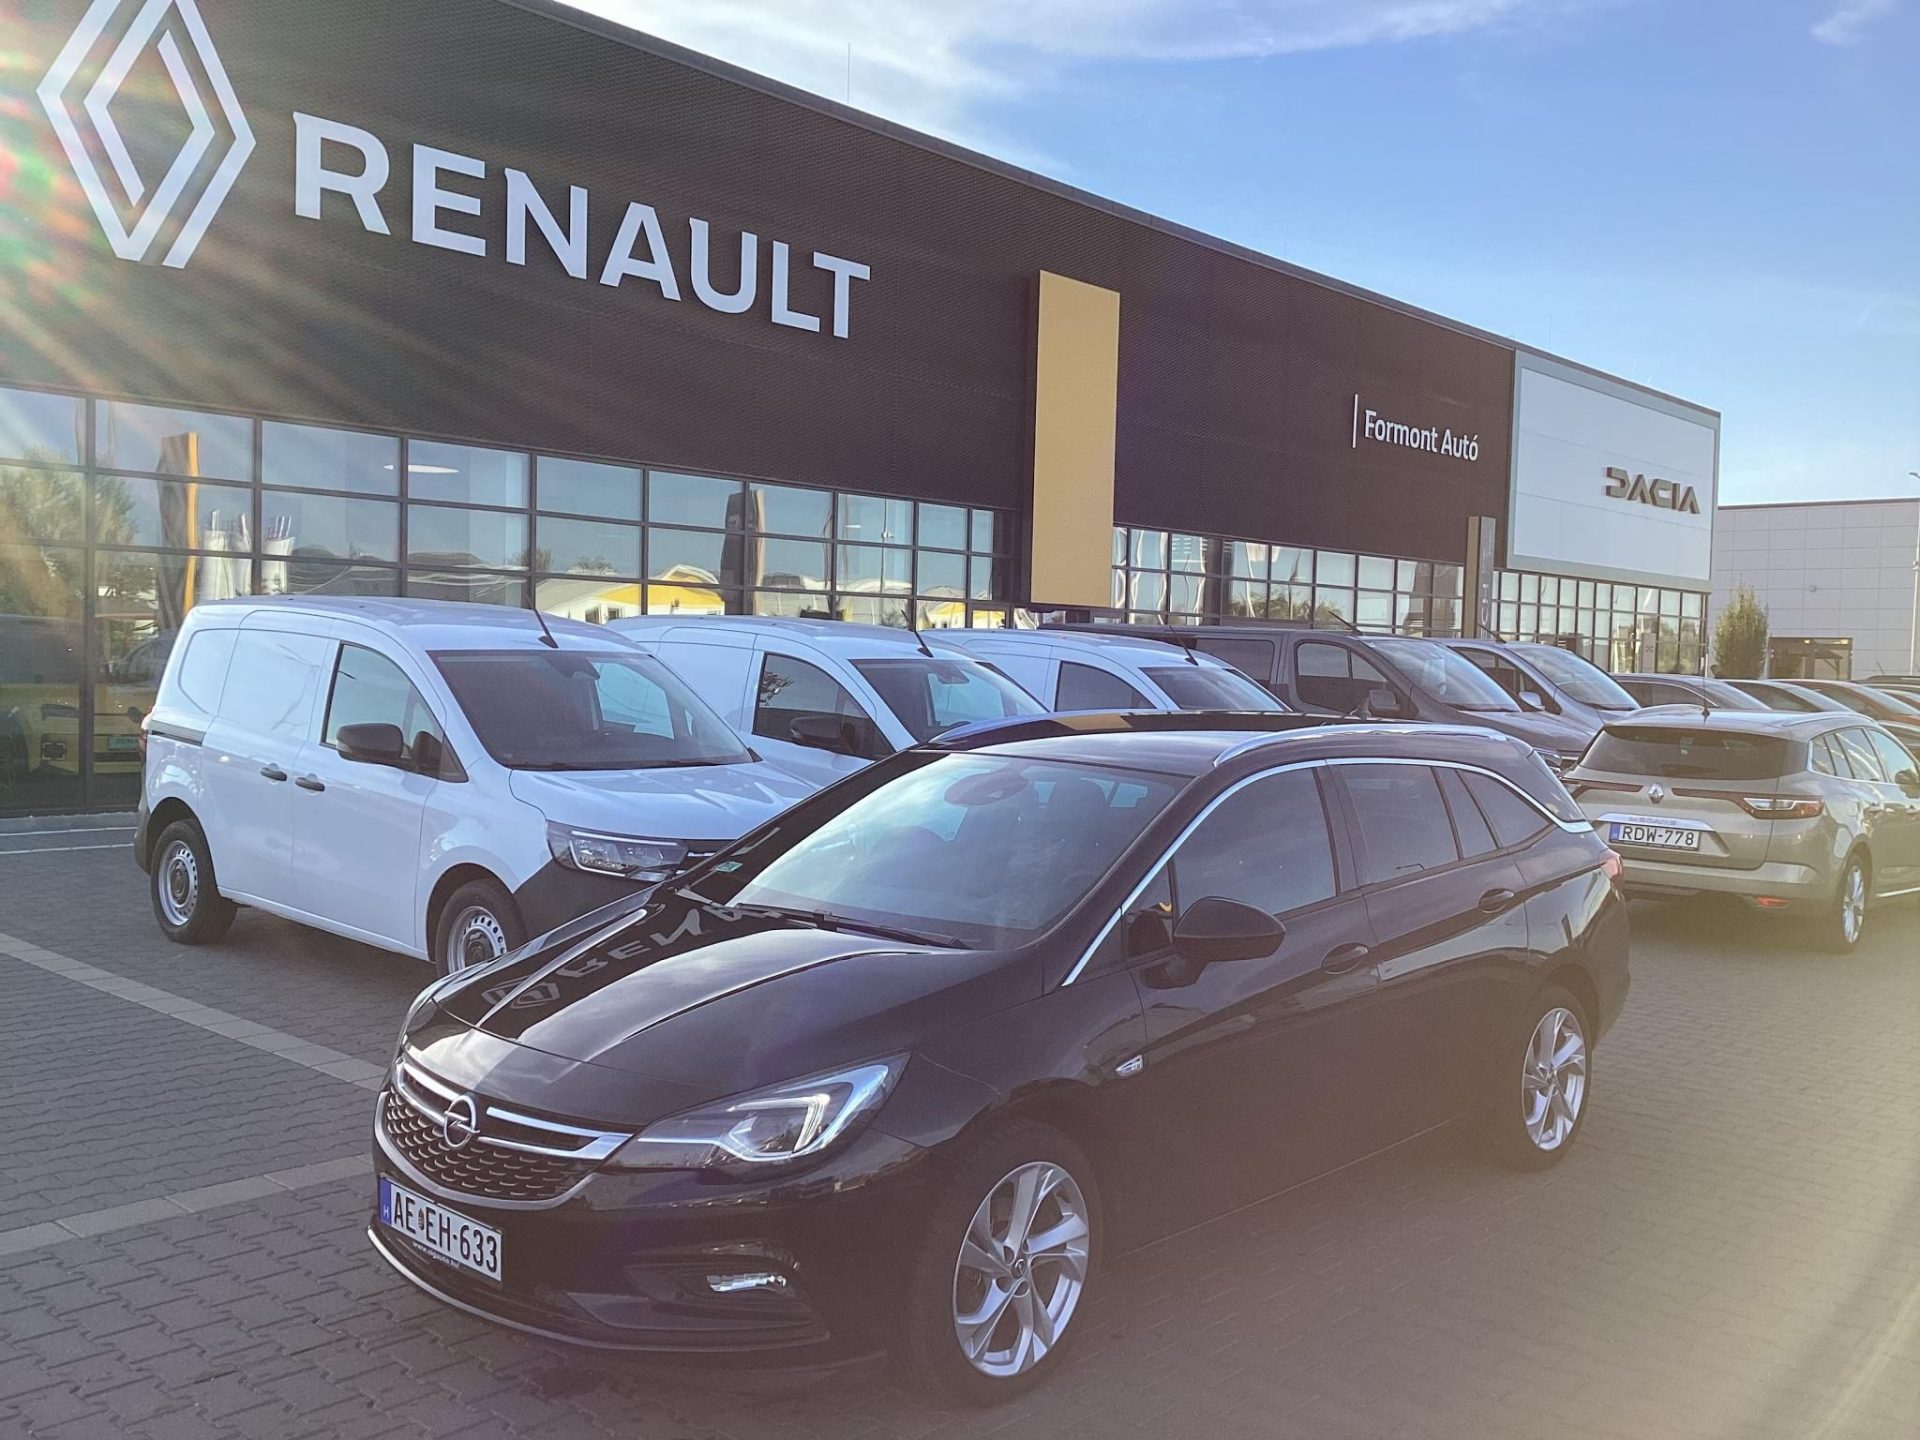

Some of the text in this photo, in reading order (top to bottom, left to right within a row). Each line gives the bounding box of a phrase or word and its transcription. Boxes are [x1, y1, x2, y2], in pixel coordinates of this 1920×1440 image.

[293, 111, 871, 339] RENAULT
[1365, 409, 1479, 461] Formont Autó
[1605, 466, 1701, 515] DACIA
[1622, 825, 1695, 846] RDW-778
[394, 1191, 417, 1235] AE
[425, 1206, 498, 1274] EH-633
